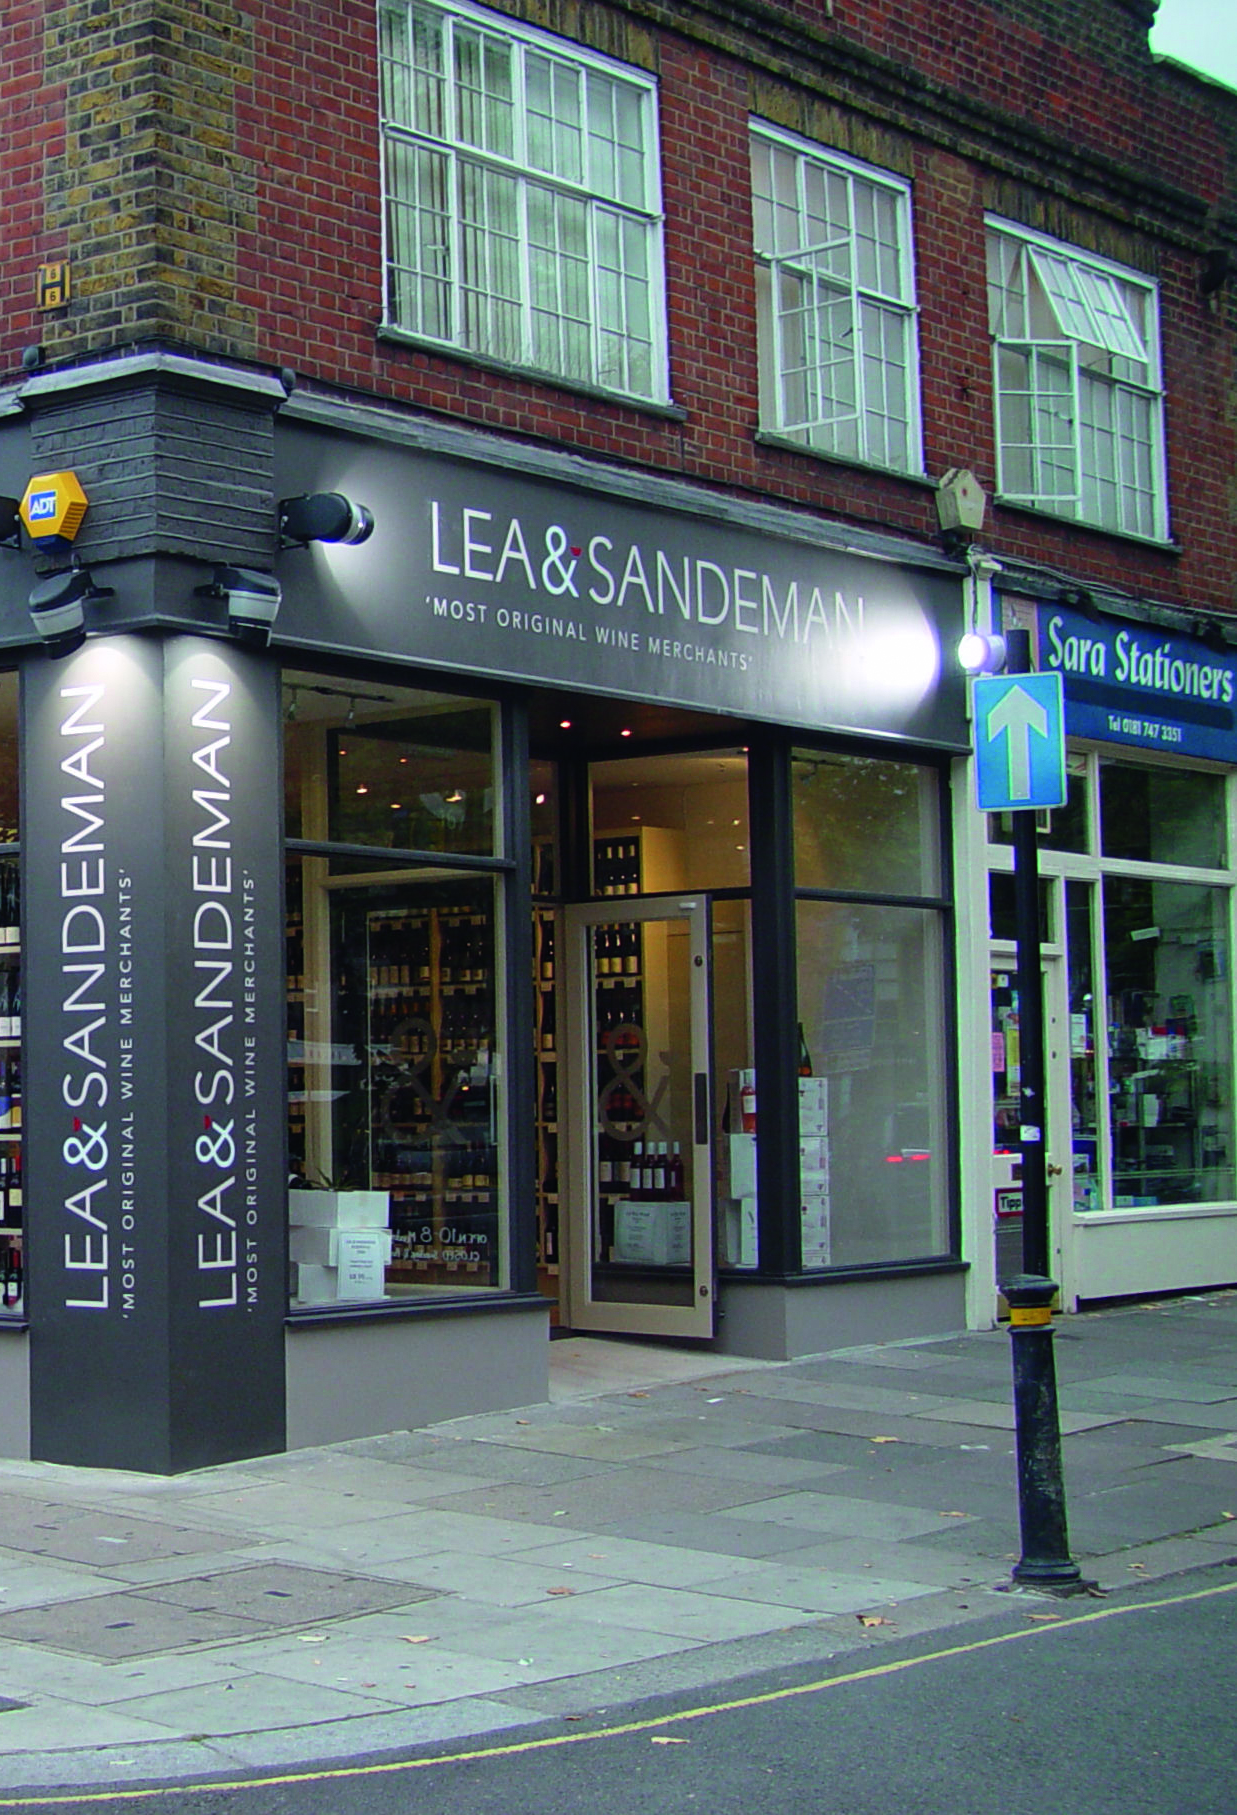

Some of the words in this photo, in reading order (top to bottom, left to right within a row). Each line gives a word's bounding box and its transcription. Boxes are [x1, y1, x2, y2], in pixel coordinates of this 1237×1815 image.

[30, 497, 56, 516] ADT
[496, 609, 587, 642] ORIGINAL
[595, 628, 640, 651] WINE
[1048, 616, 1106, 677] Sara
[1115, 630, 1234, 703] Stationers
[1107, 714, 1121, 733] Tel
[1142, 721, 1161, 739] 747
[120, 1037, 134, 1100] WINE
[244, 1035, 257, 1098] WINE
[120, 1111, 135, 1231] ORIGINAL
[245, 1107, 258, 1228] ORIGINAL
